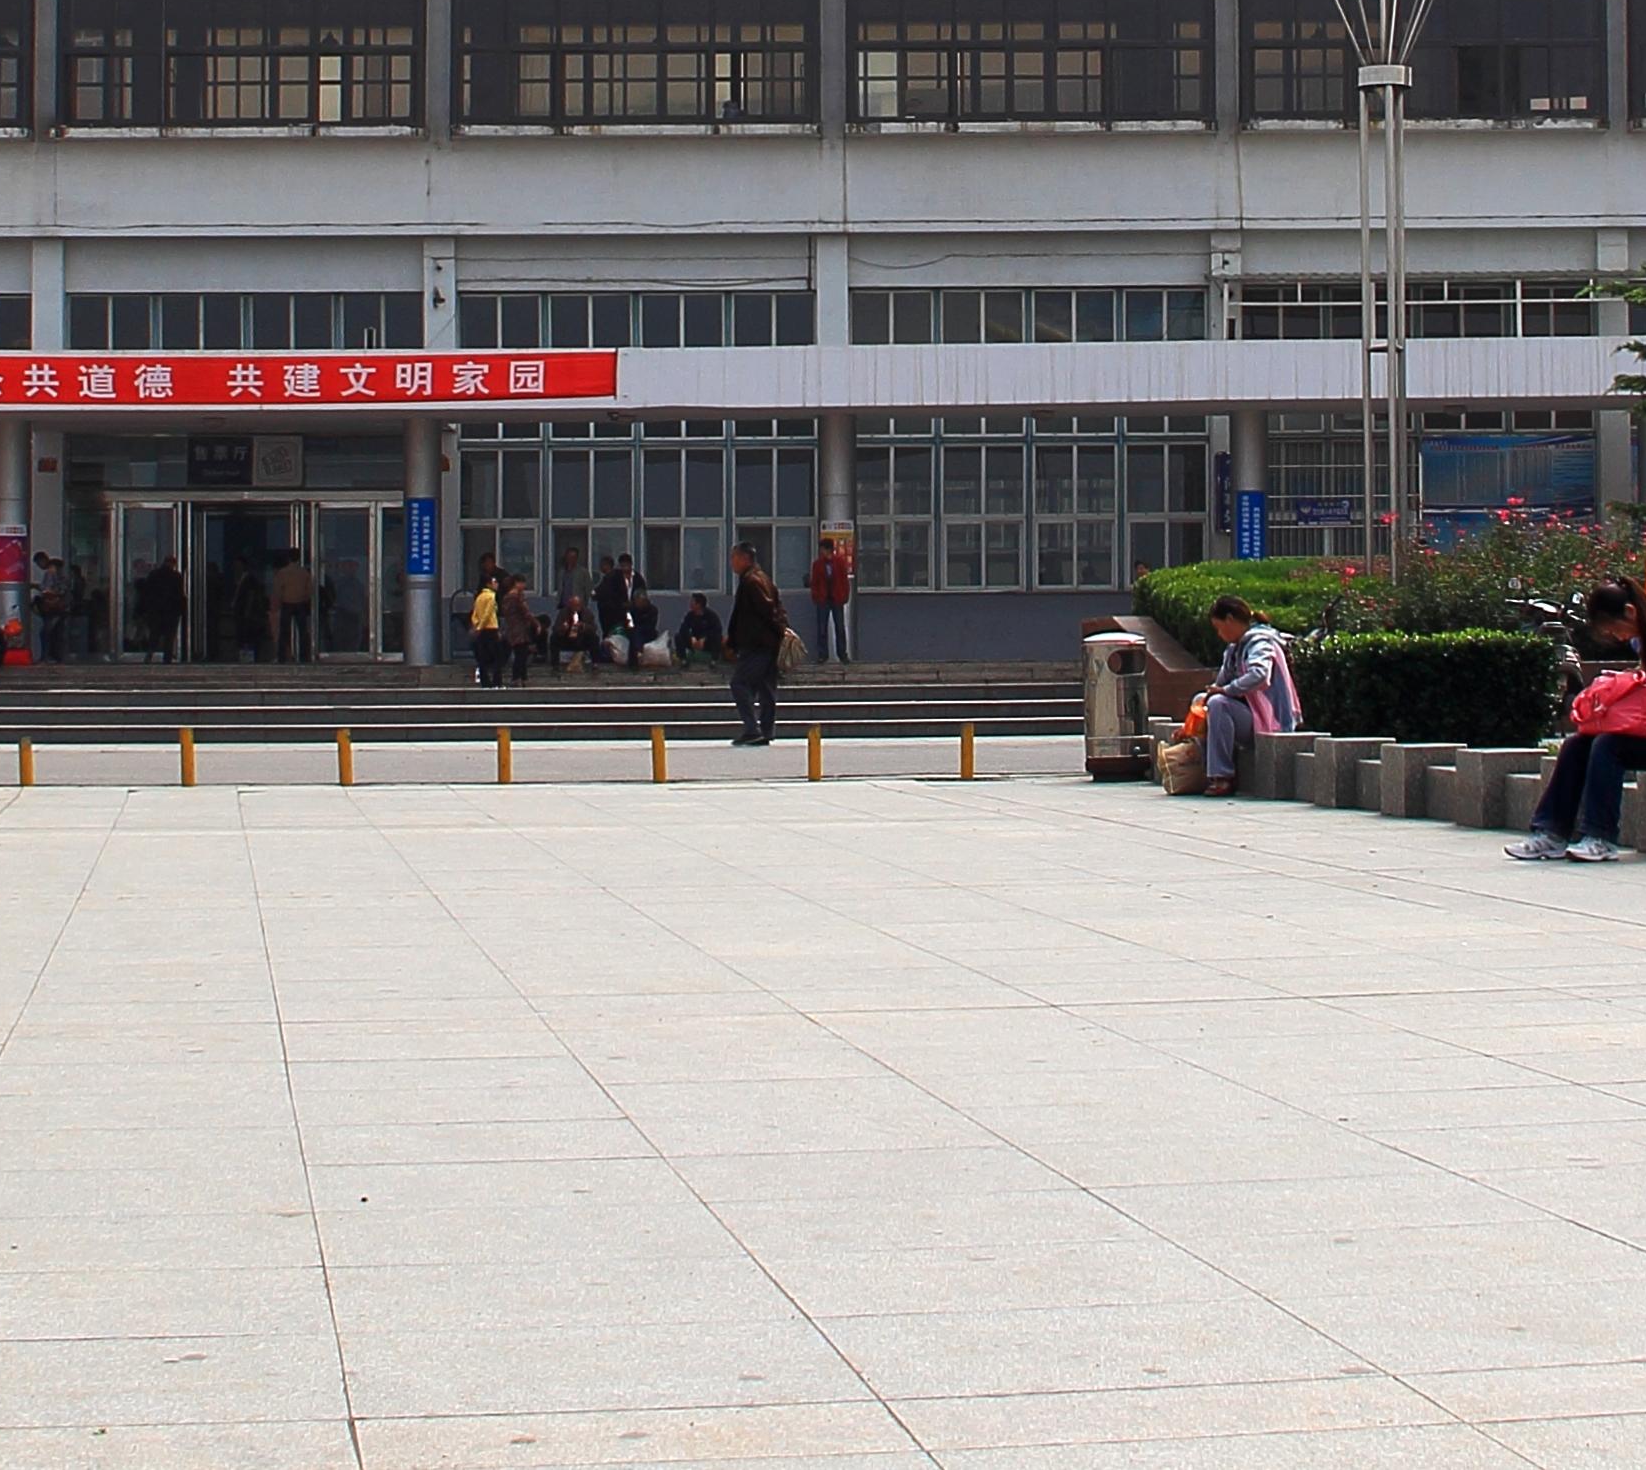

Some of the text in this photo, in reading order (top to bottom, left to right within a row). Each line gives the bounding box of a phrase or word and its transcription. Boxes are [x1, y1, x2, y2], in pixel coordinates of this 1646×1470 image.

[226, 360, 546, 396] 共建文明家园
